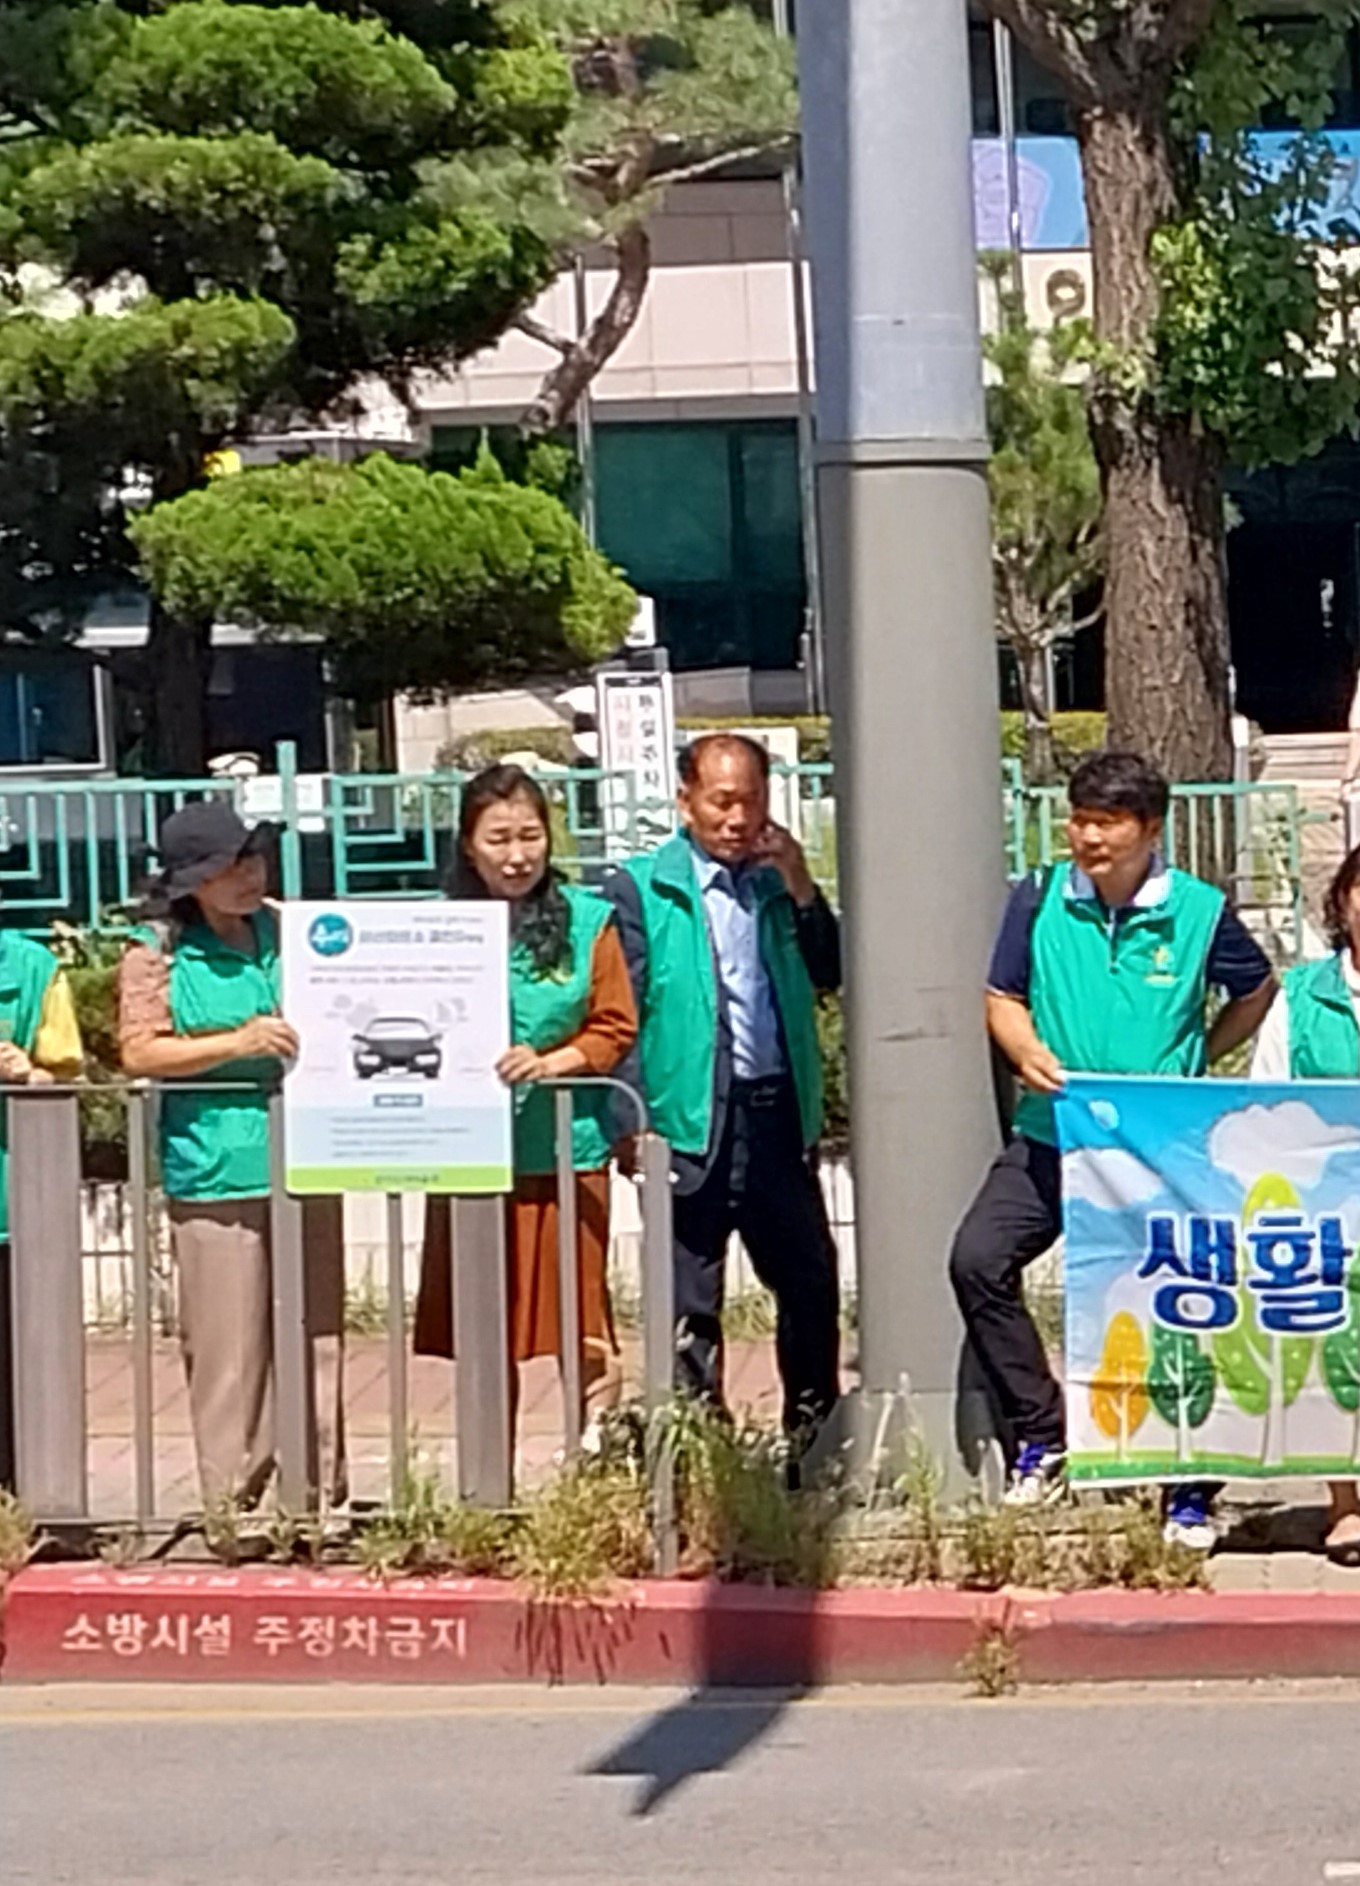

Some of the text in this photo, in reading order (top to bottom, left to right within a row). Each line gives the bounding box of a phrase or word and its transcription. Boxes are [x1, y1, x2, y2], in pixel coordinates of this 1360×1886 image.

[1137, 1213, 1354, 1333] 생활
[60, 1613, 467, 1659] 소방시설 주정차금지
